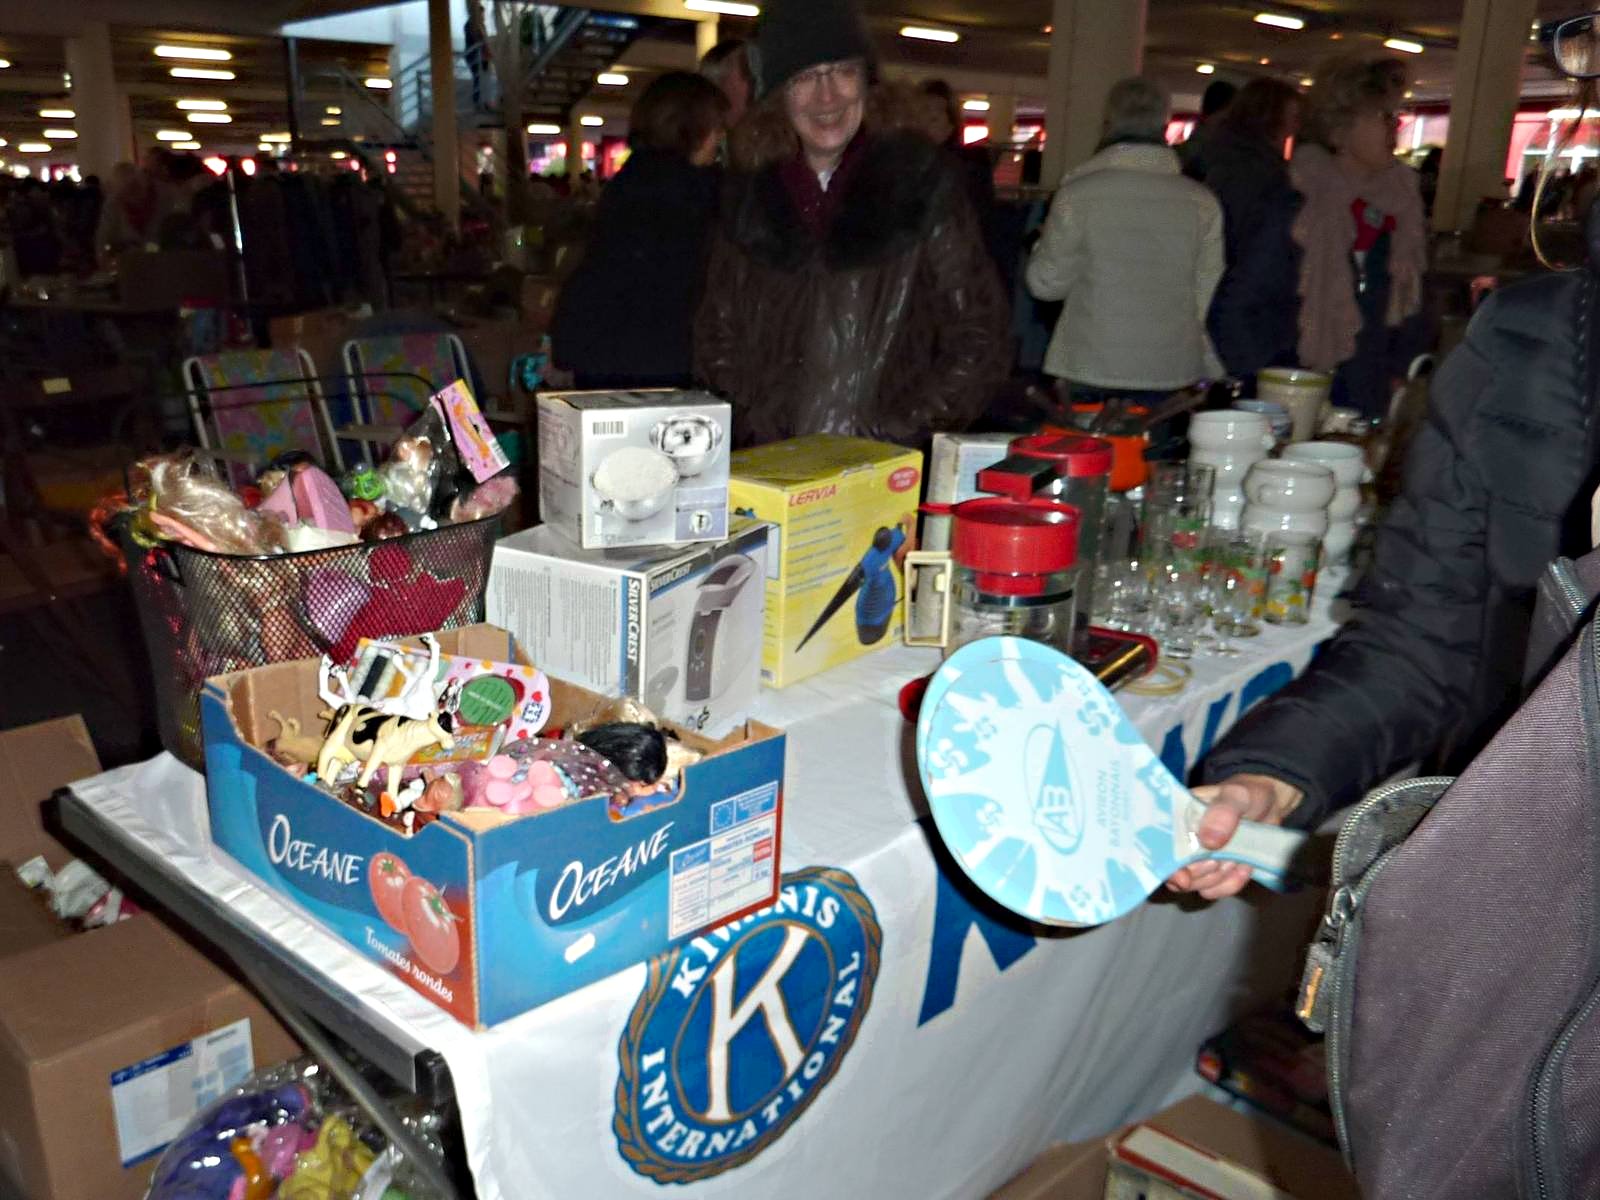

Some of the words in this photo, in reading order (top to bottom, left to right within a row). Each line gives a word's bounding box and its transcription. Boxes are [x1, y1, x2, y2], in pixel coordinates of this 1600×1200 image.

[268, 813, 364, 885] OCEANE
[549, 821, 675, 920] OCEANE
[365, 926, 411, 974] Tomates
[412, 966, 454, 1004] rondes
[671, 885, 841, 999] KINIS
[642, 951, 859, 1159] INTERNATIONAL
[706, 924, 810, 1120] K
